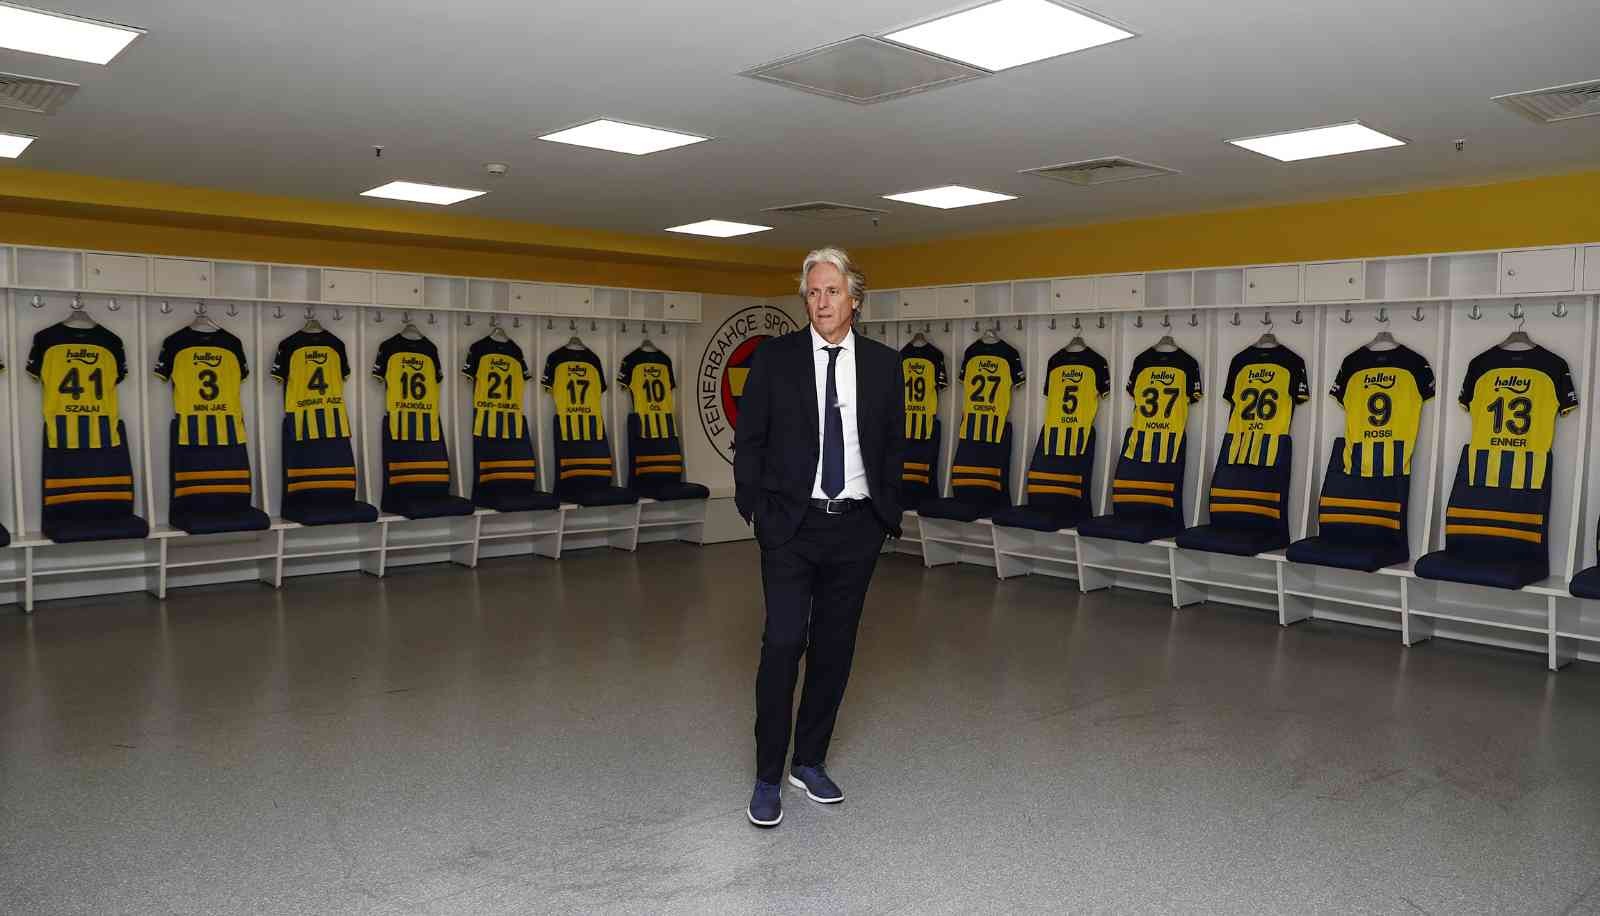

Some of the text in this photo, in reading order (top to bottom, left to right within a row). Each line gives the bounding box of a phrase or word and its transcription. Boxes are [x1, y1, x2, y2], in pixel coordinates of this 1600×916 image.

[66, 349, 100, 365] halley
[193, 352, 223, 367] halley
[58, 367, 103, 400] 41
[198, 369, 219, 400] 3
[307, 367, 328, 395] 4
[400, 372, 426, 400] 16
[488, 372, 512, 400] 21
[702, 312, 790, 437] FENERBAHÇE SPO
[906, 376, 926, 401] 19
[1151, 371, 1175, 385] halley
[1248, 370, 1275, 384] halley
[1364, 373, 1396, 389] halley
[1494, 376, 1531, 393] halley
[566, 380, 591, 404] 17
[642, 380, 665, 402] 10
[970, 375, 1001, 403] 27
[1062, 386, 1079, 414] 5
[1140, 388, 1179, 418] 37
[1240, 388, 1278, 420] 26
[1367, 392, 1392, 426] 9
[1487, 397, 1532, 435] 13
[1363, 430, 1393, 439] ROSSI
[1489, 437, 1528, 447] ENNER
